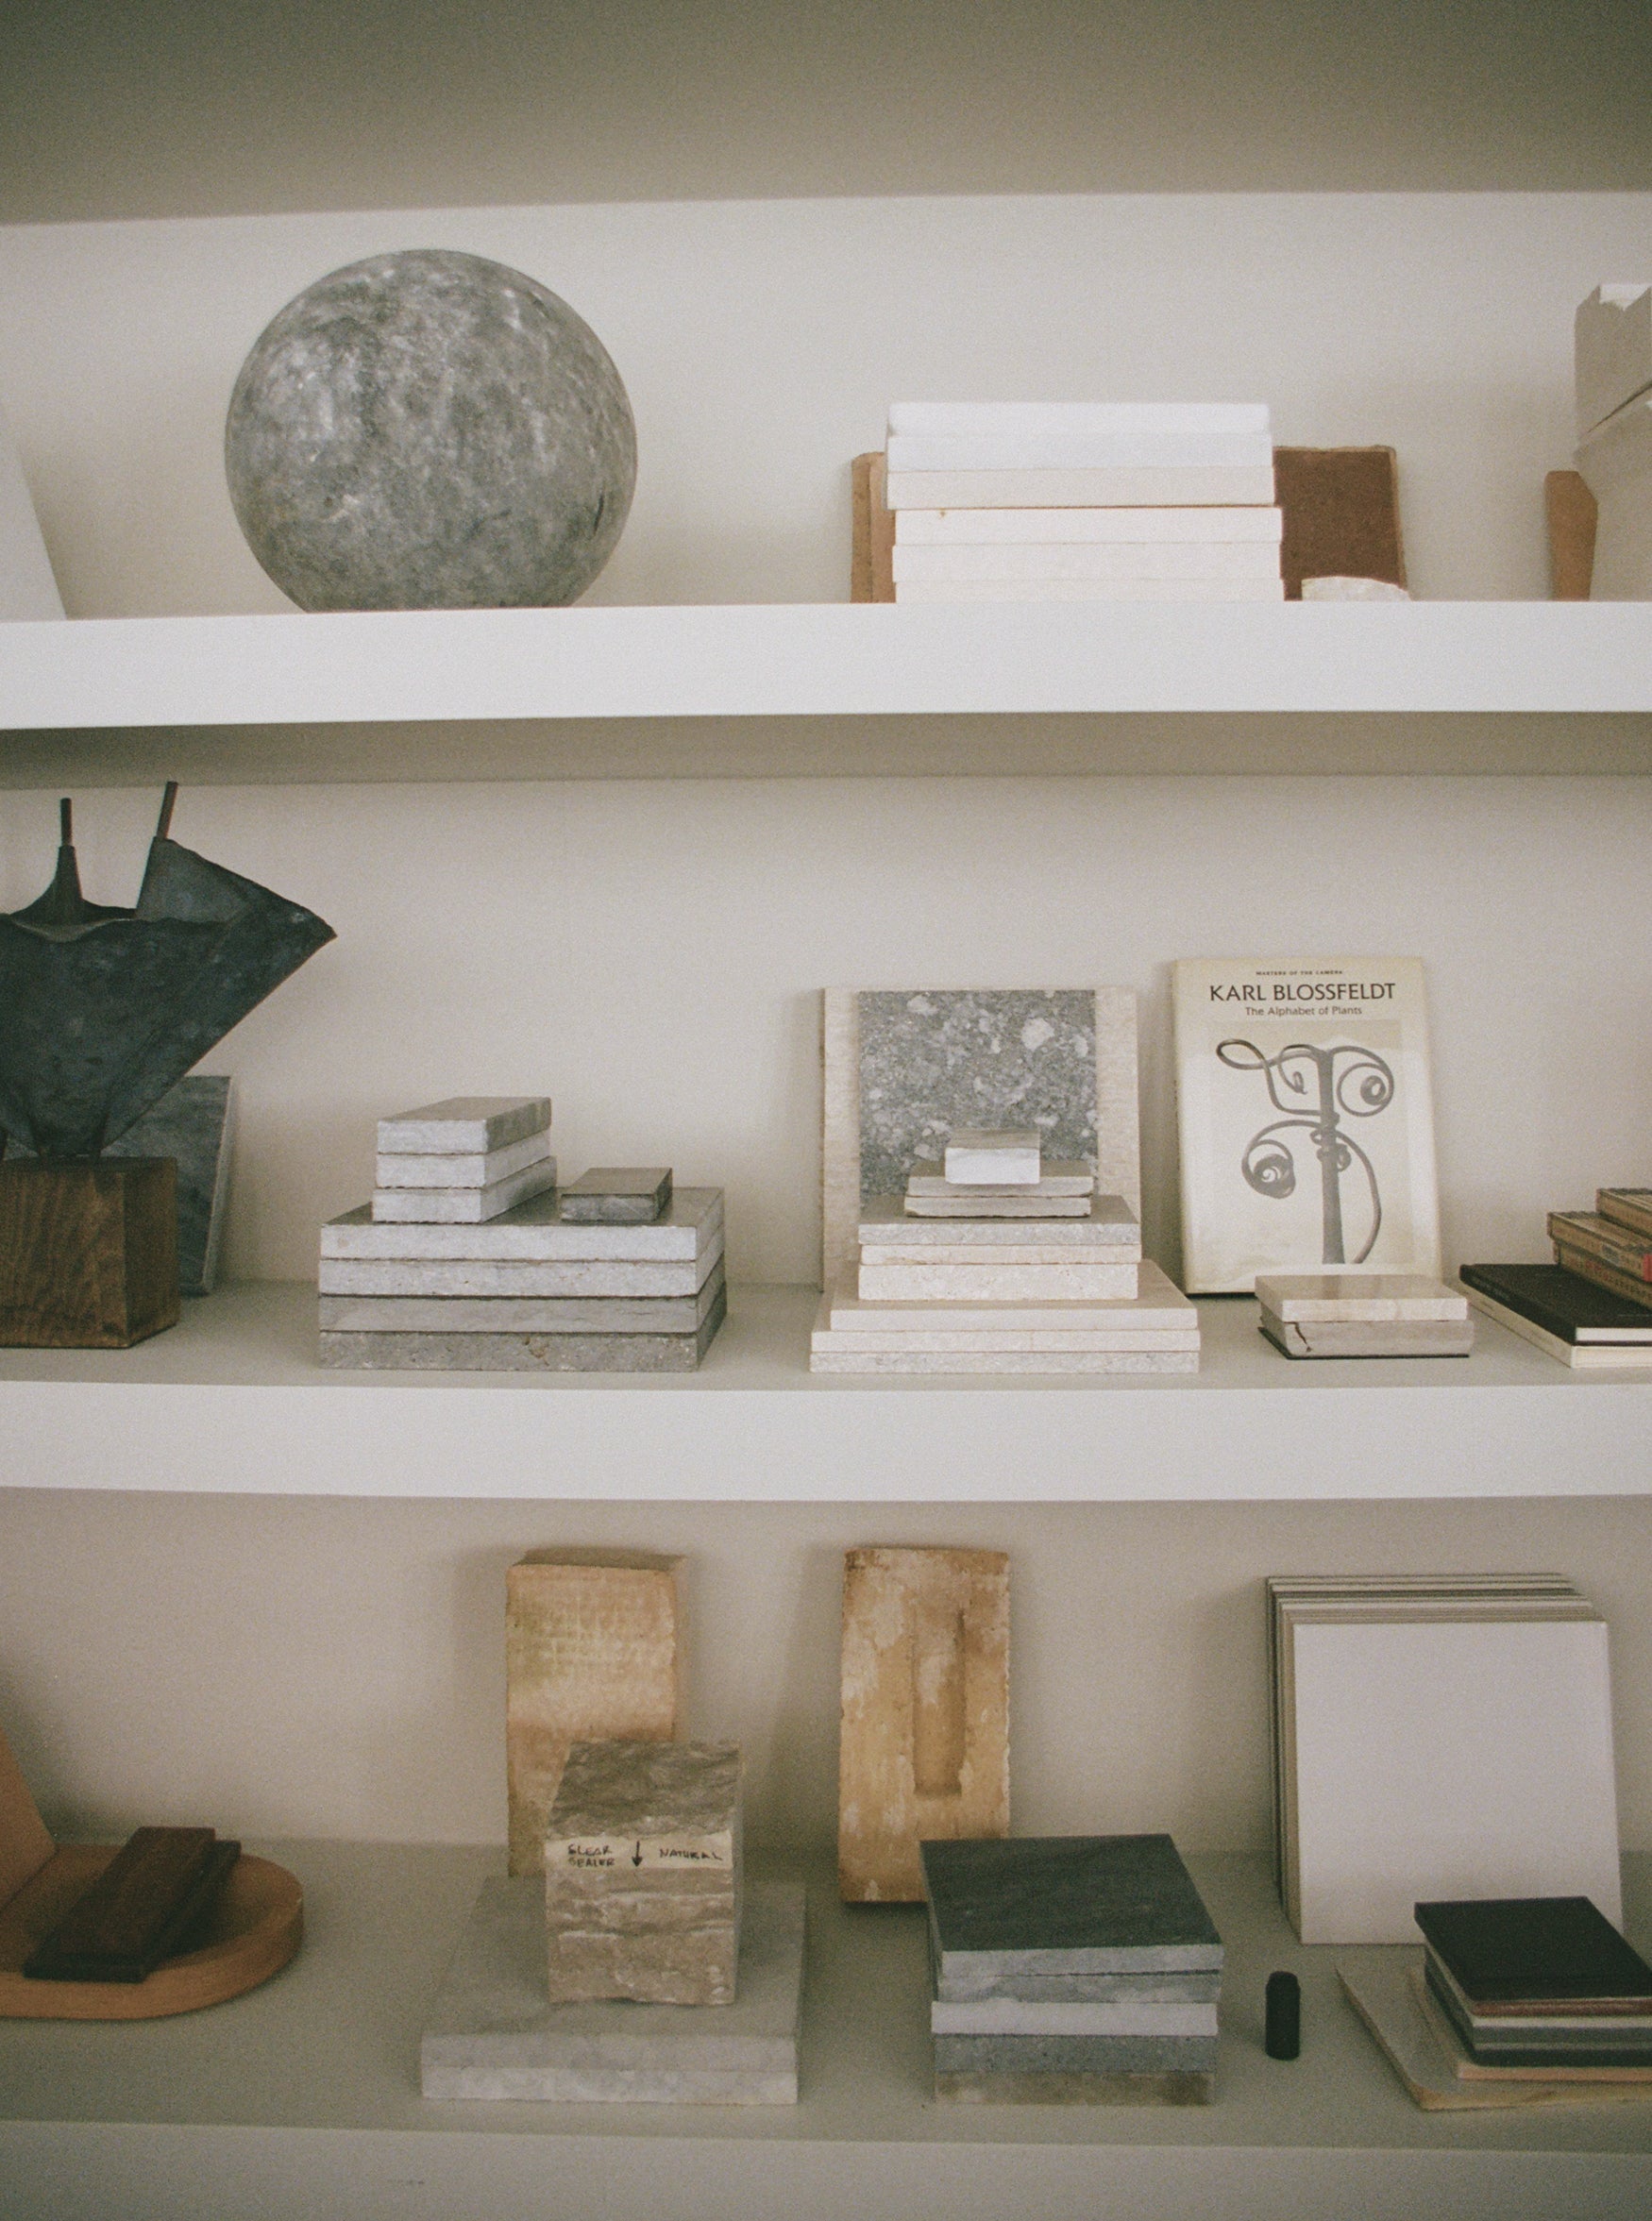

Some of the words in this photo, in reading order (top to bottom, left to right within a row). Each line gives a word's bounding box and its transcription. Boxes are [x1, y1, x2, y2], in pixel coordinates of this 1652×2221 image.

[1209, 984, 1267, 1001] KARL
[1273, 983, 1396, 1001] BLOSSFELDT
[1245, 1006, 1266, 1016] The
[1268, 1006, 1314, 1017] Alphabet
[1318, 1006, 1329, 1015] of
[1332, 1005, 1362, 1015] Plants
[660, 1847, 723, 1861] NATURAL
